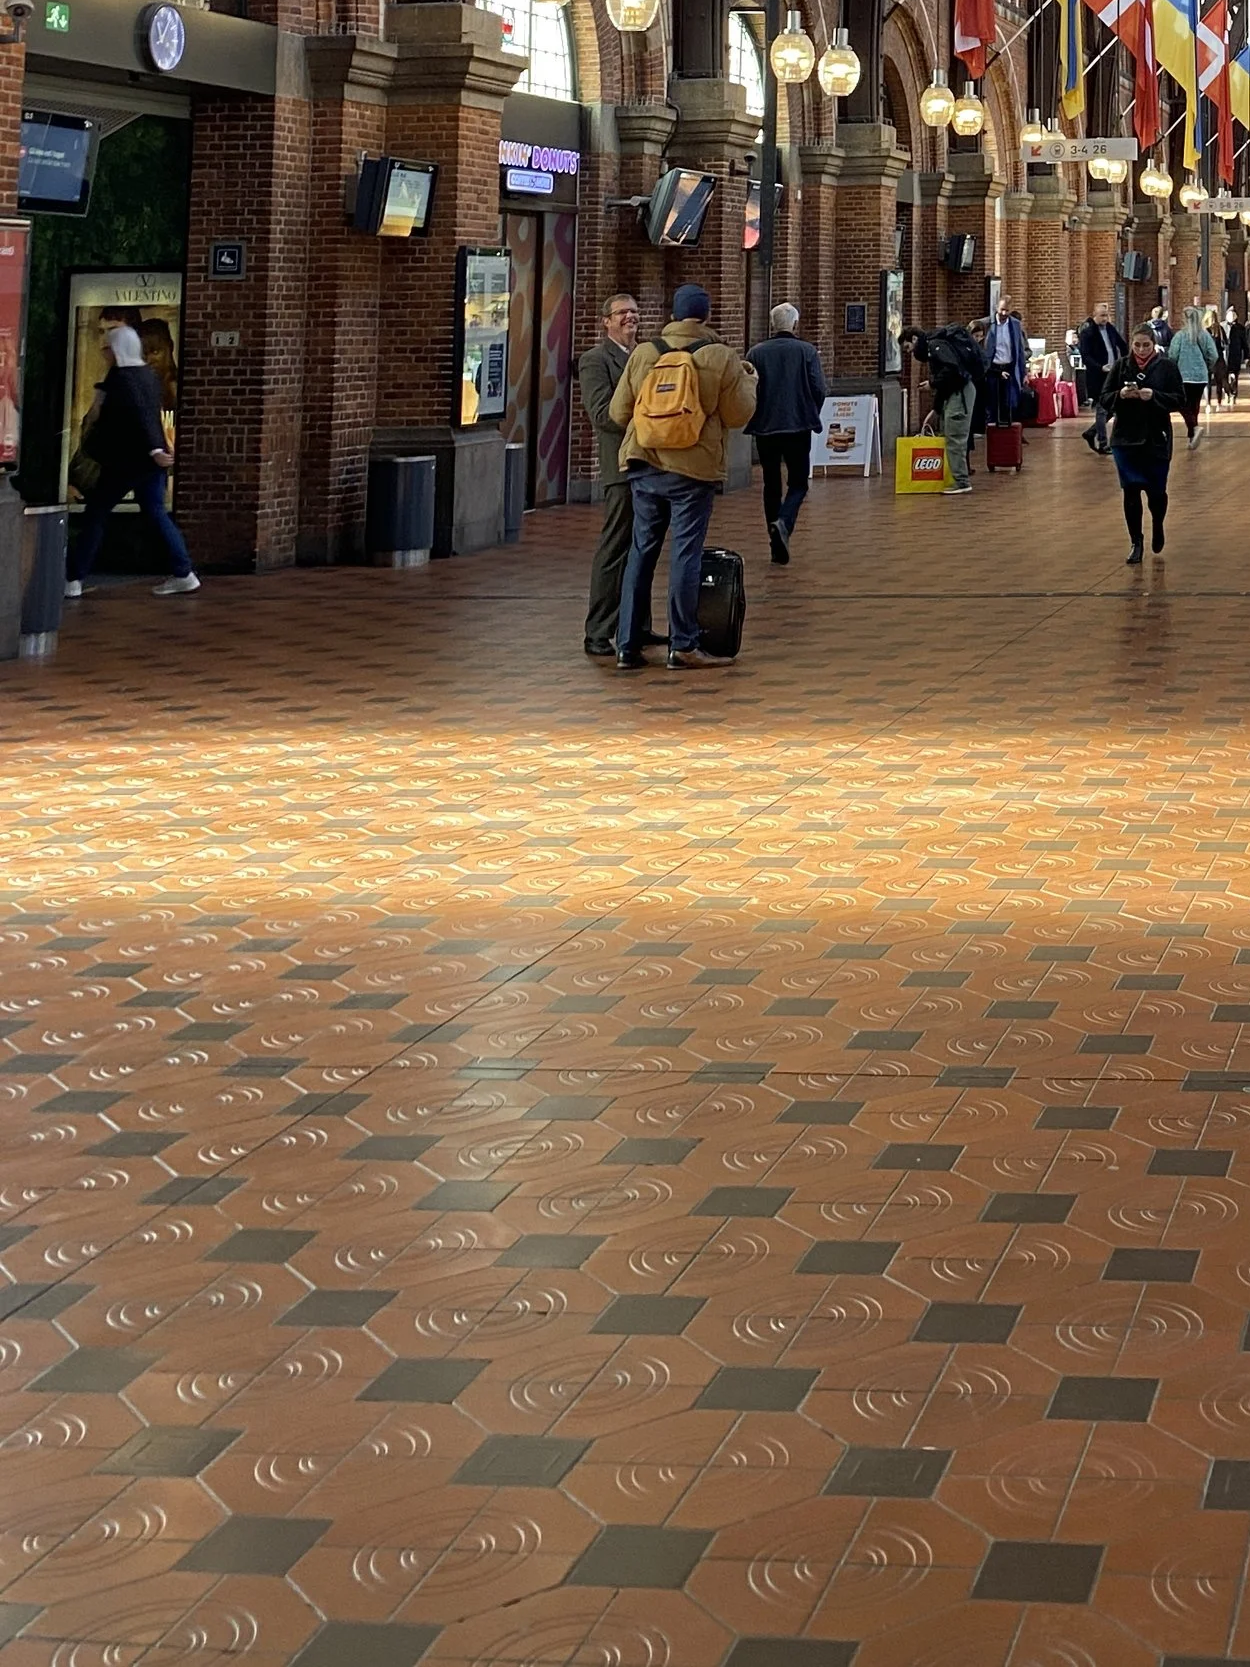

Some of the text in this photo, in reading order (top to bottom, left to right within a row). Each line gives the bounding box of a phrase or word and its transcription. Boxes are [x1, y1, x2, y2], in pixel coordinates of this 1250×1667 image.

[1070, 144, 1107, 155] 3-4 26
[531, 145, 578, 176] DONUTS
[115, 288, 177, 302] VALENTINO
[228, 337, 234, 345] 2
[914, 458, 942, 470] LEGO
